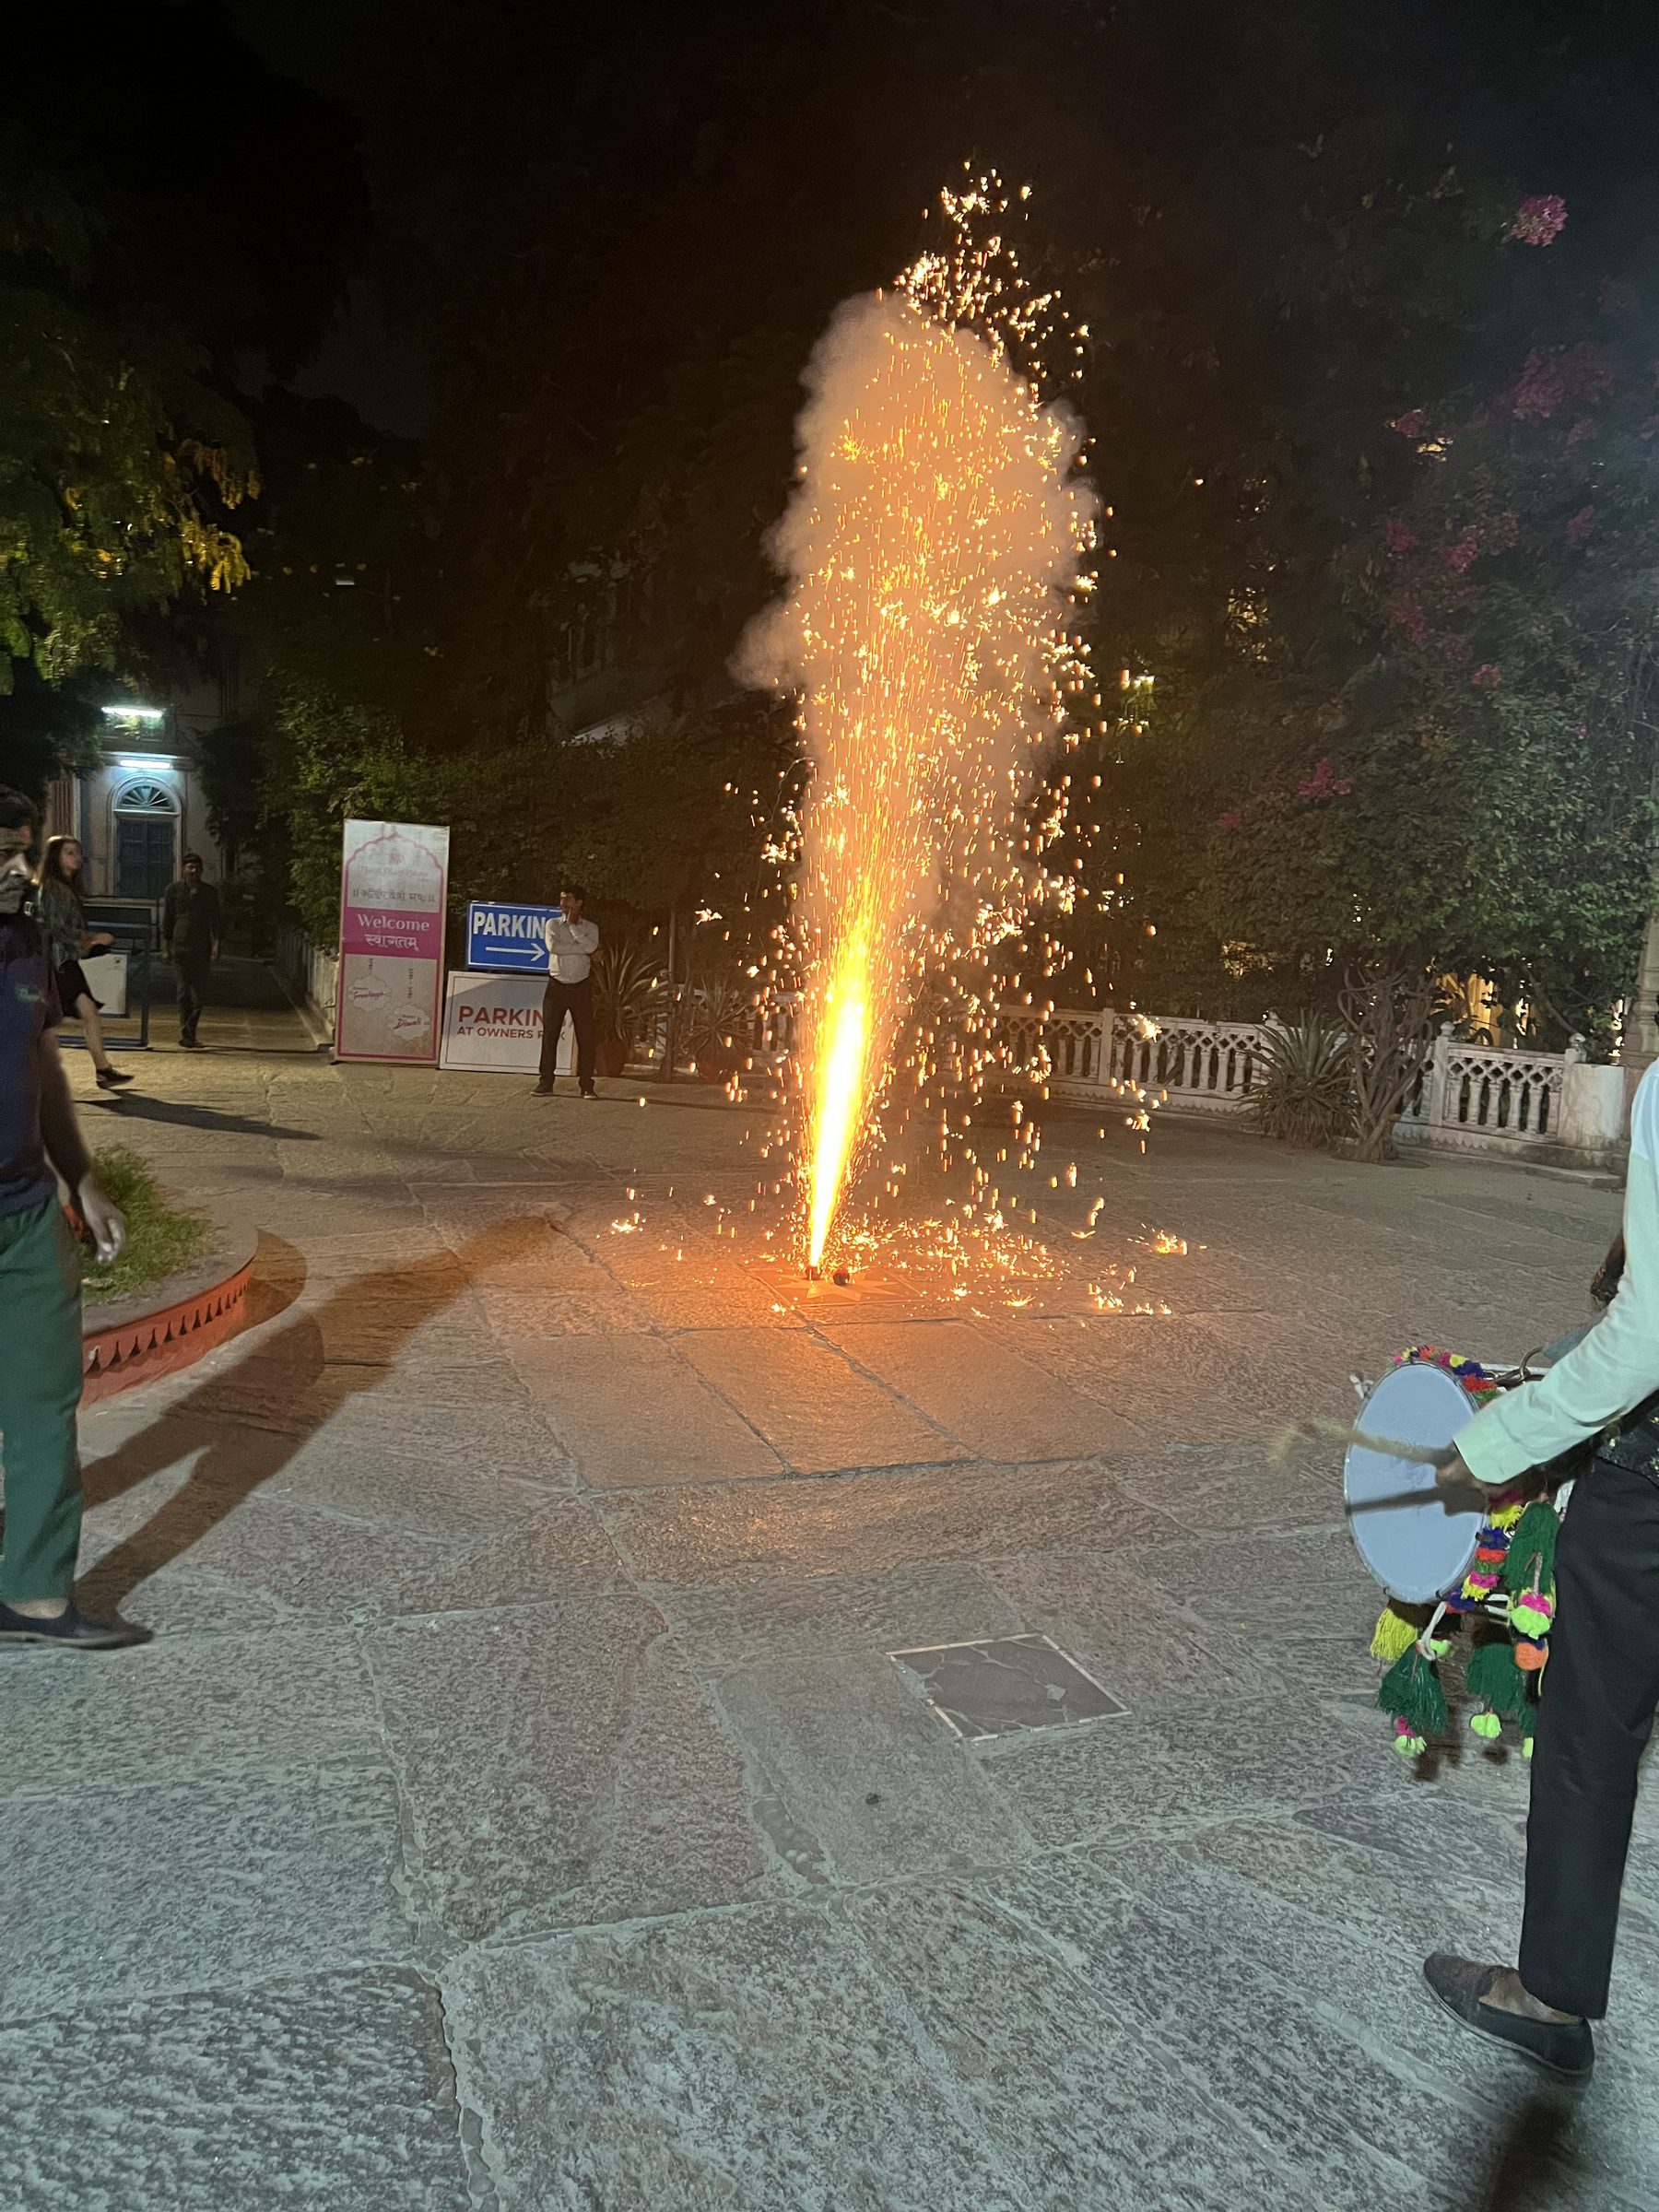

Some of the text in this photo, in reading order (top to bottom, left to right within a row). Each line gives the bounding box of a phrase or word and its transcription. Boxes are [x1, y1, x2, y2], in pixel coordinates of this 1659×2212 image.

[357, 913, 429, 932] Welcome
[473, 911, 547, 940] PARKIN
[363, 934, 420, 953] स्वागतम्
[458, 1006, 566, 1028] PARKIN
[456, 1026, 474, 1036] AT
[477, 1027, 534, 1040] OWNERS
